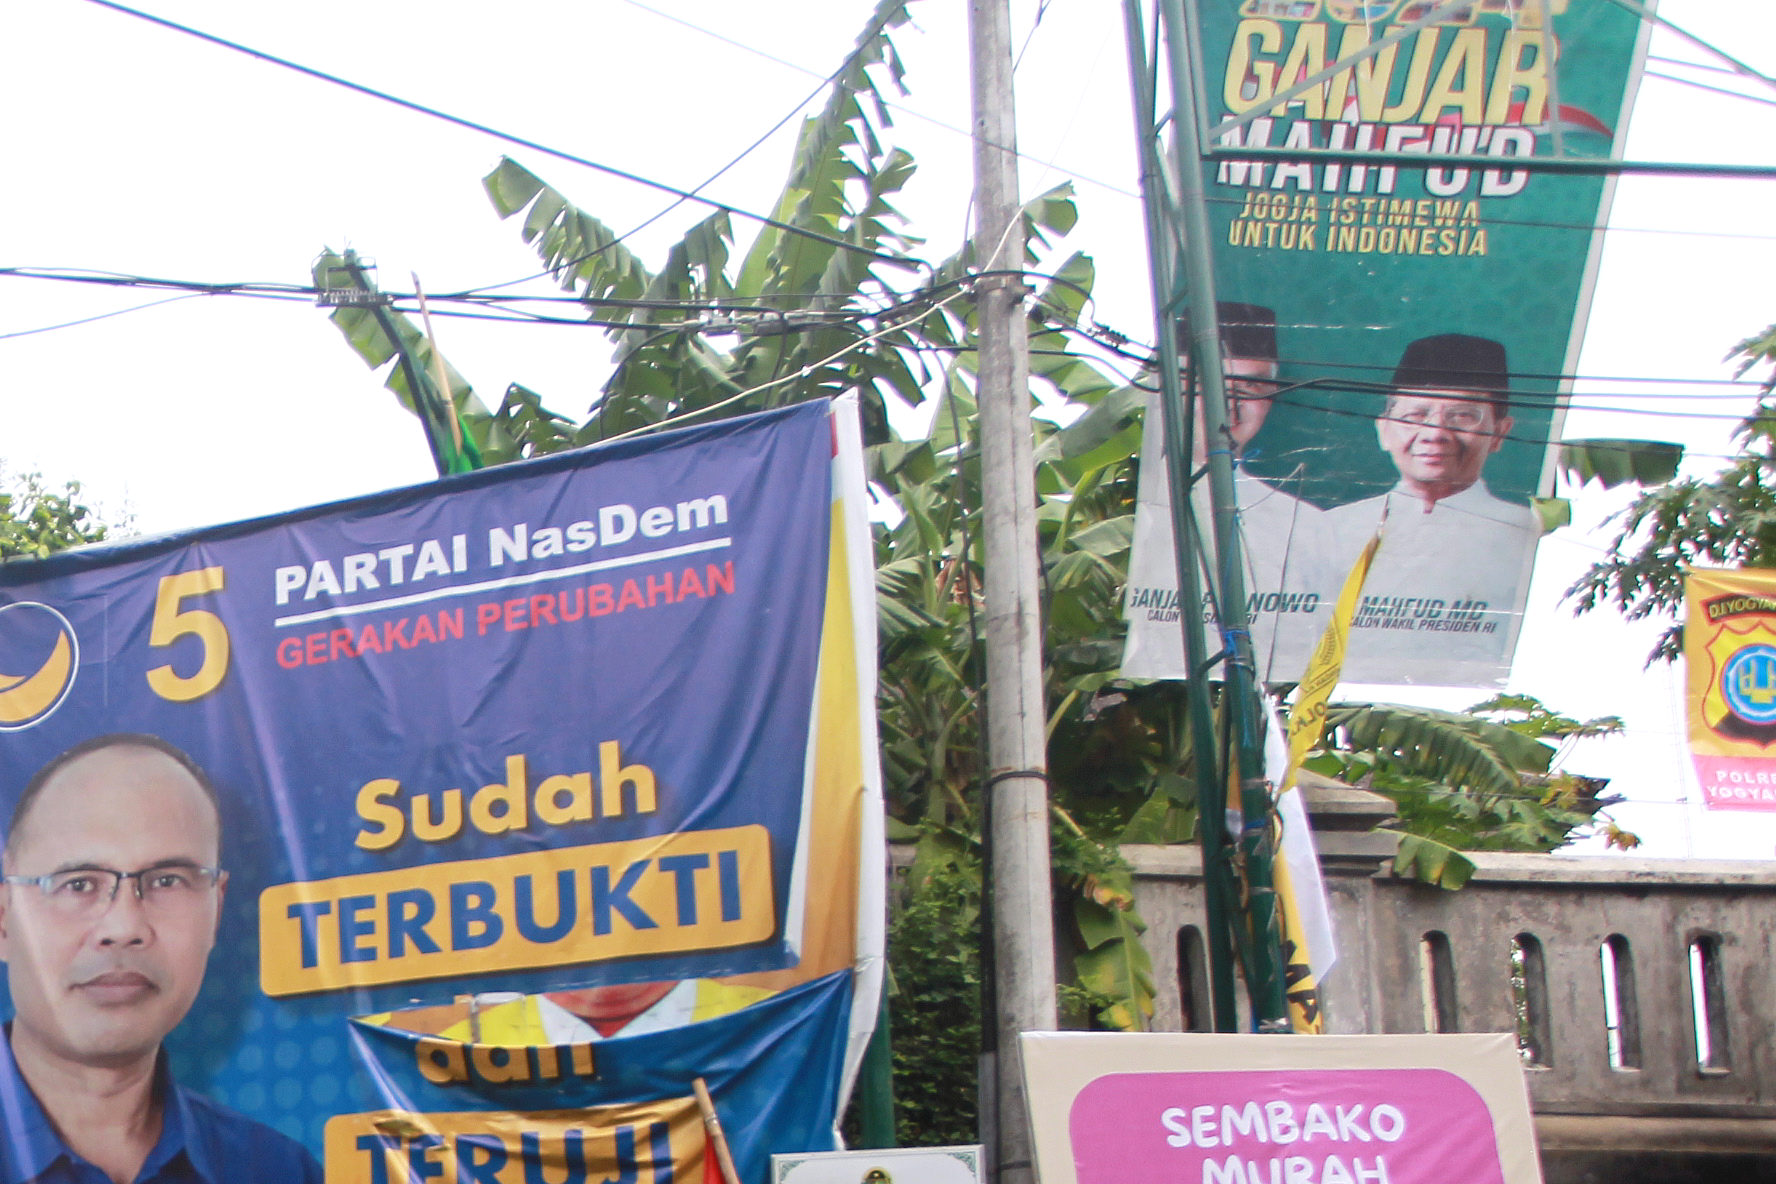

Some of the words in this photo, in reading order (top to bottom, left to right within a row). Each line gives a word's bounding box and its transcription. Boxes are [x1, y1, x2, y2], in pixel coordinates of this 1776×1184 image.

[1224, 18, 1561, 126] GANJAR
[1216, 116, 1536, 198] MAHFUD
[1228, 220, 1316, 251] UNTUK
[1326, 224, 1489, 257] INDONESIA
[1240, 192, 1319, 224] JOGJA
[1329, 198, 1481, 229] ISTIMEWA
[275, 534, 467, 605] PARTAI
[488, 494, 728, 567] NasDem
[146, 565, 231, 702] 5
[276, 607, 465, 670] GERAKAN
[477, 561, 736, 637] PERUBAHAN
[1350, 616, 1380, 628] ALON
[1382, 618, 1414, 631] WAKIL
[1417, 619, 1480, 633] PRESIDEN
[1358, 596, 1444, 619] MAHFUD
[1446, 600, 1489, 620] MD
[354, 739, 656, 850] Sudah
[1707, 785, 1776, 800] YOGYA
[288, 849, 743, 969] TERBUKTI
[1161, 1100, 1406, 1149] SEMBAKO
